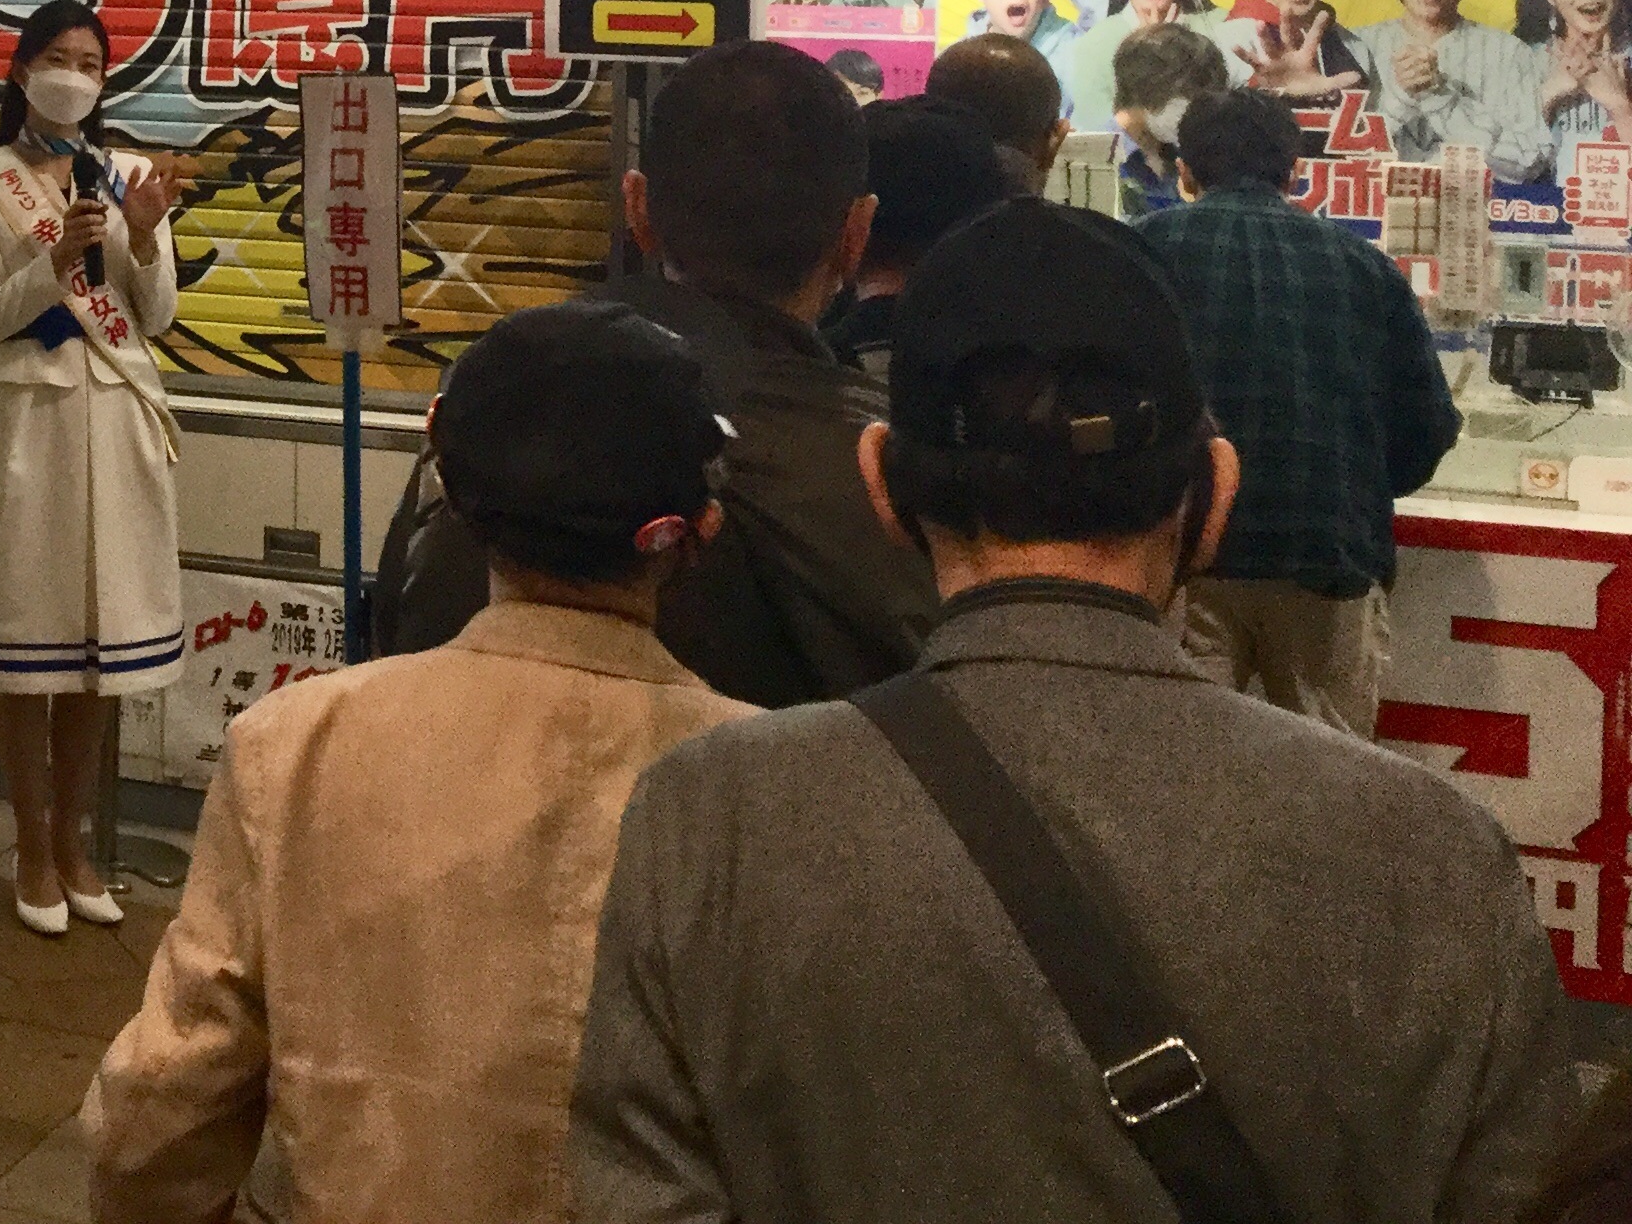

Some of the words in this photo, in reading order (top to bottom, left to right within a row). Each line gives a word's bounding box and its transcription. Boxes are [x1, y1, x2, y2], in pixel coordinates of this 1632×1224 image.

[31, 216, 130, 348] 幸の女神
[325, 81, 371, 317] 出口専用
